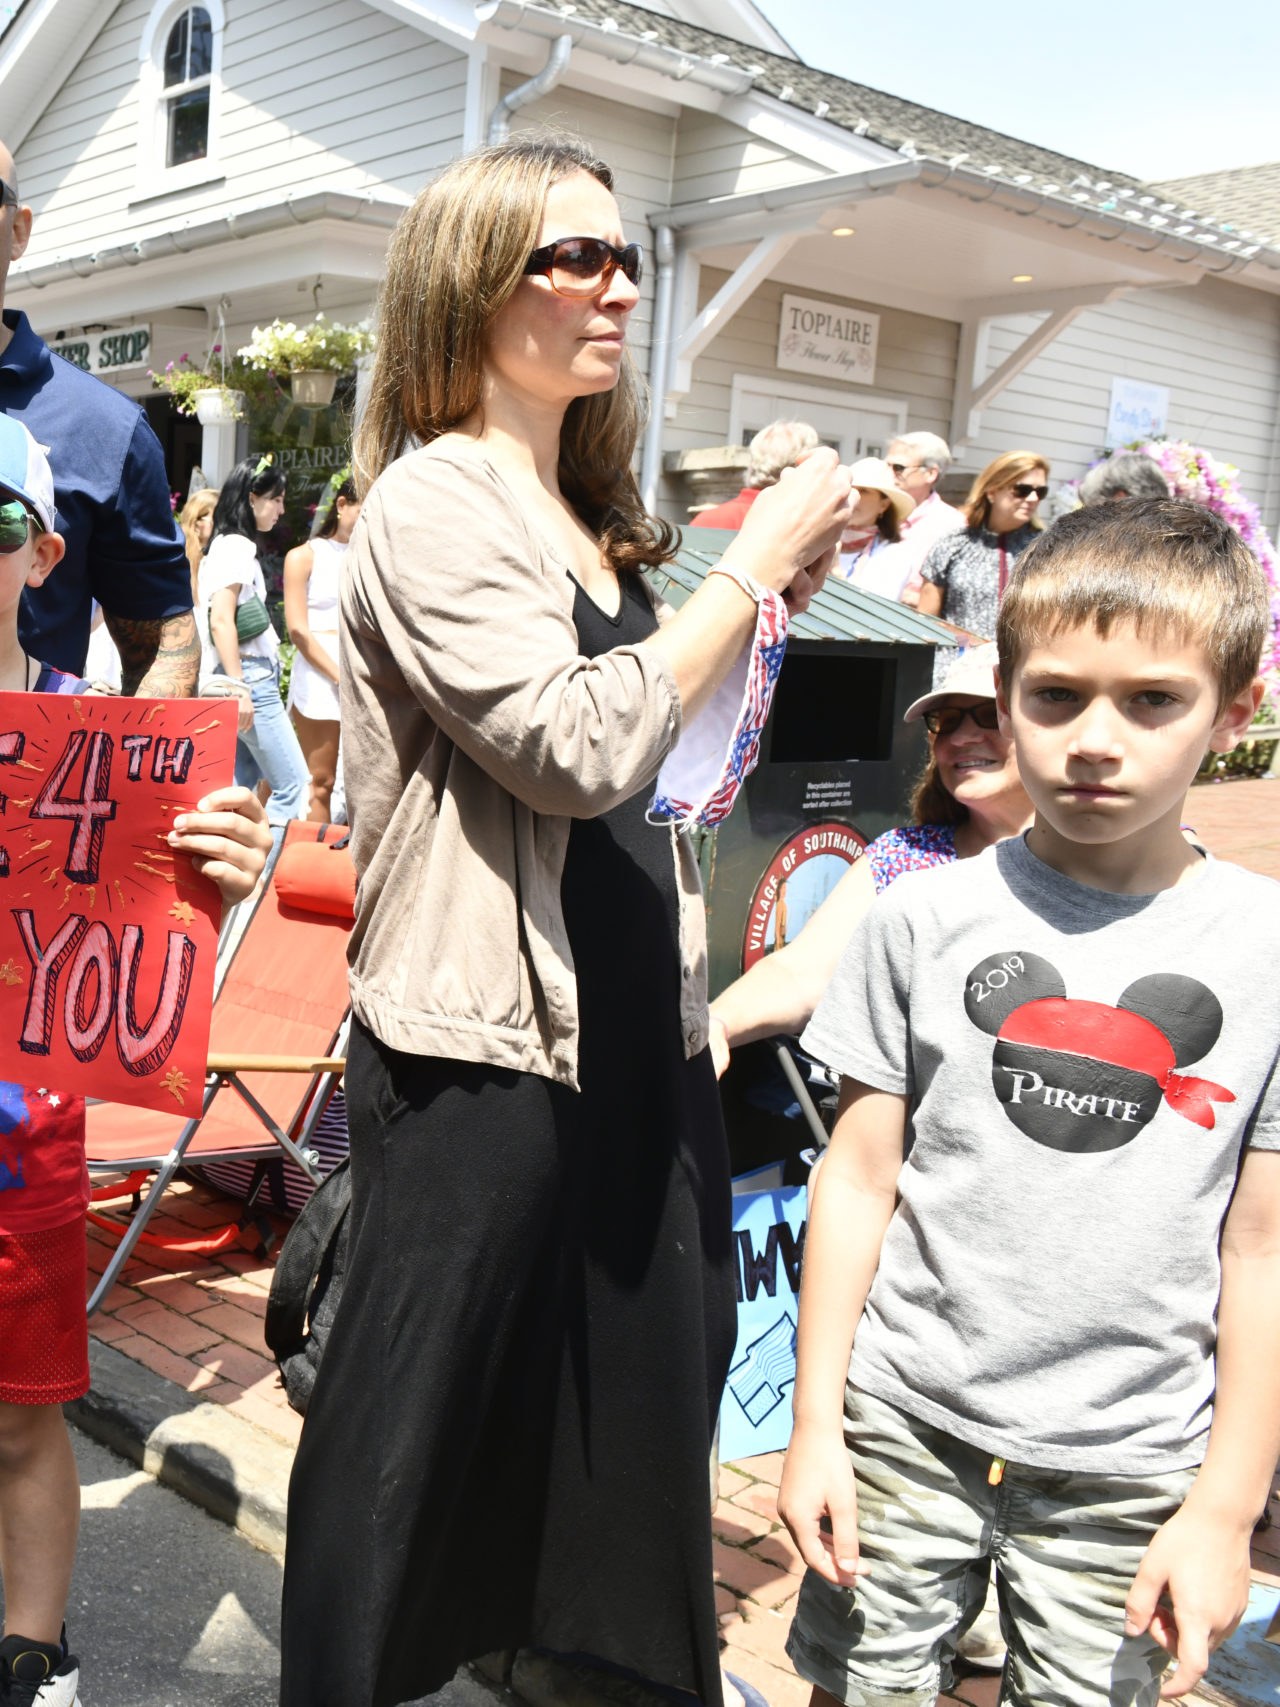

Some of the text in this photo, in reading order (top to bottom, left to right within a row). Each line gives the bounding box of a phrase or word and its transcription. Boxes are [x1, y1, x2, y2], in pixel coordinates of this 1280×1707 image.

[790, 307, 872, 346] TOPIAIRE
[99, 330, 150, 368] SHOP
[801, 341, 856, 372] Flower Shop
[807, 781, 851, 790] Recyclables placed
[781, 848, 797, 872] OF
[11, 908, 197, 1077] YOU
[970, 955, 1025, 1003] 2019
